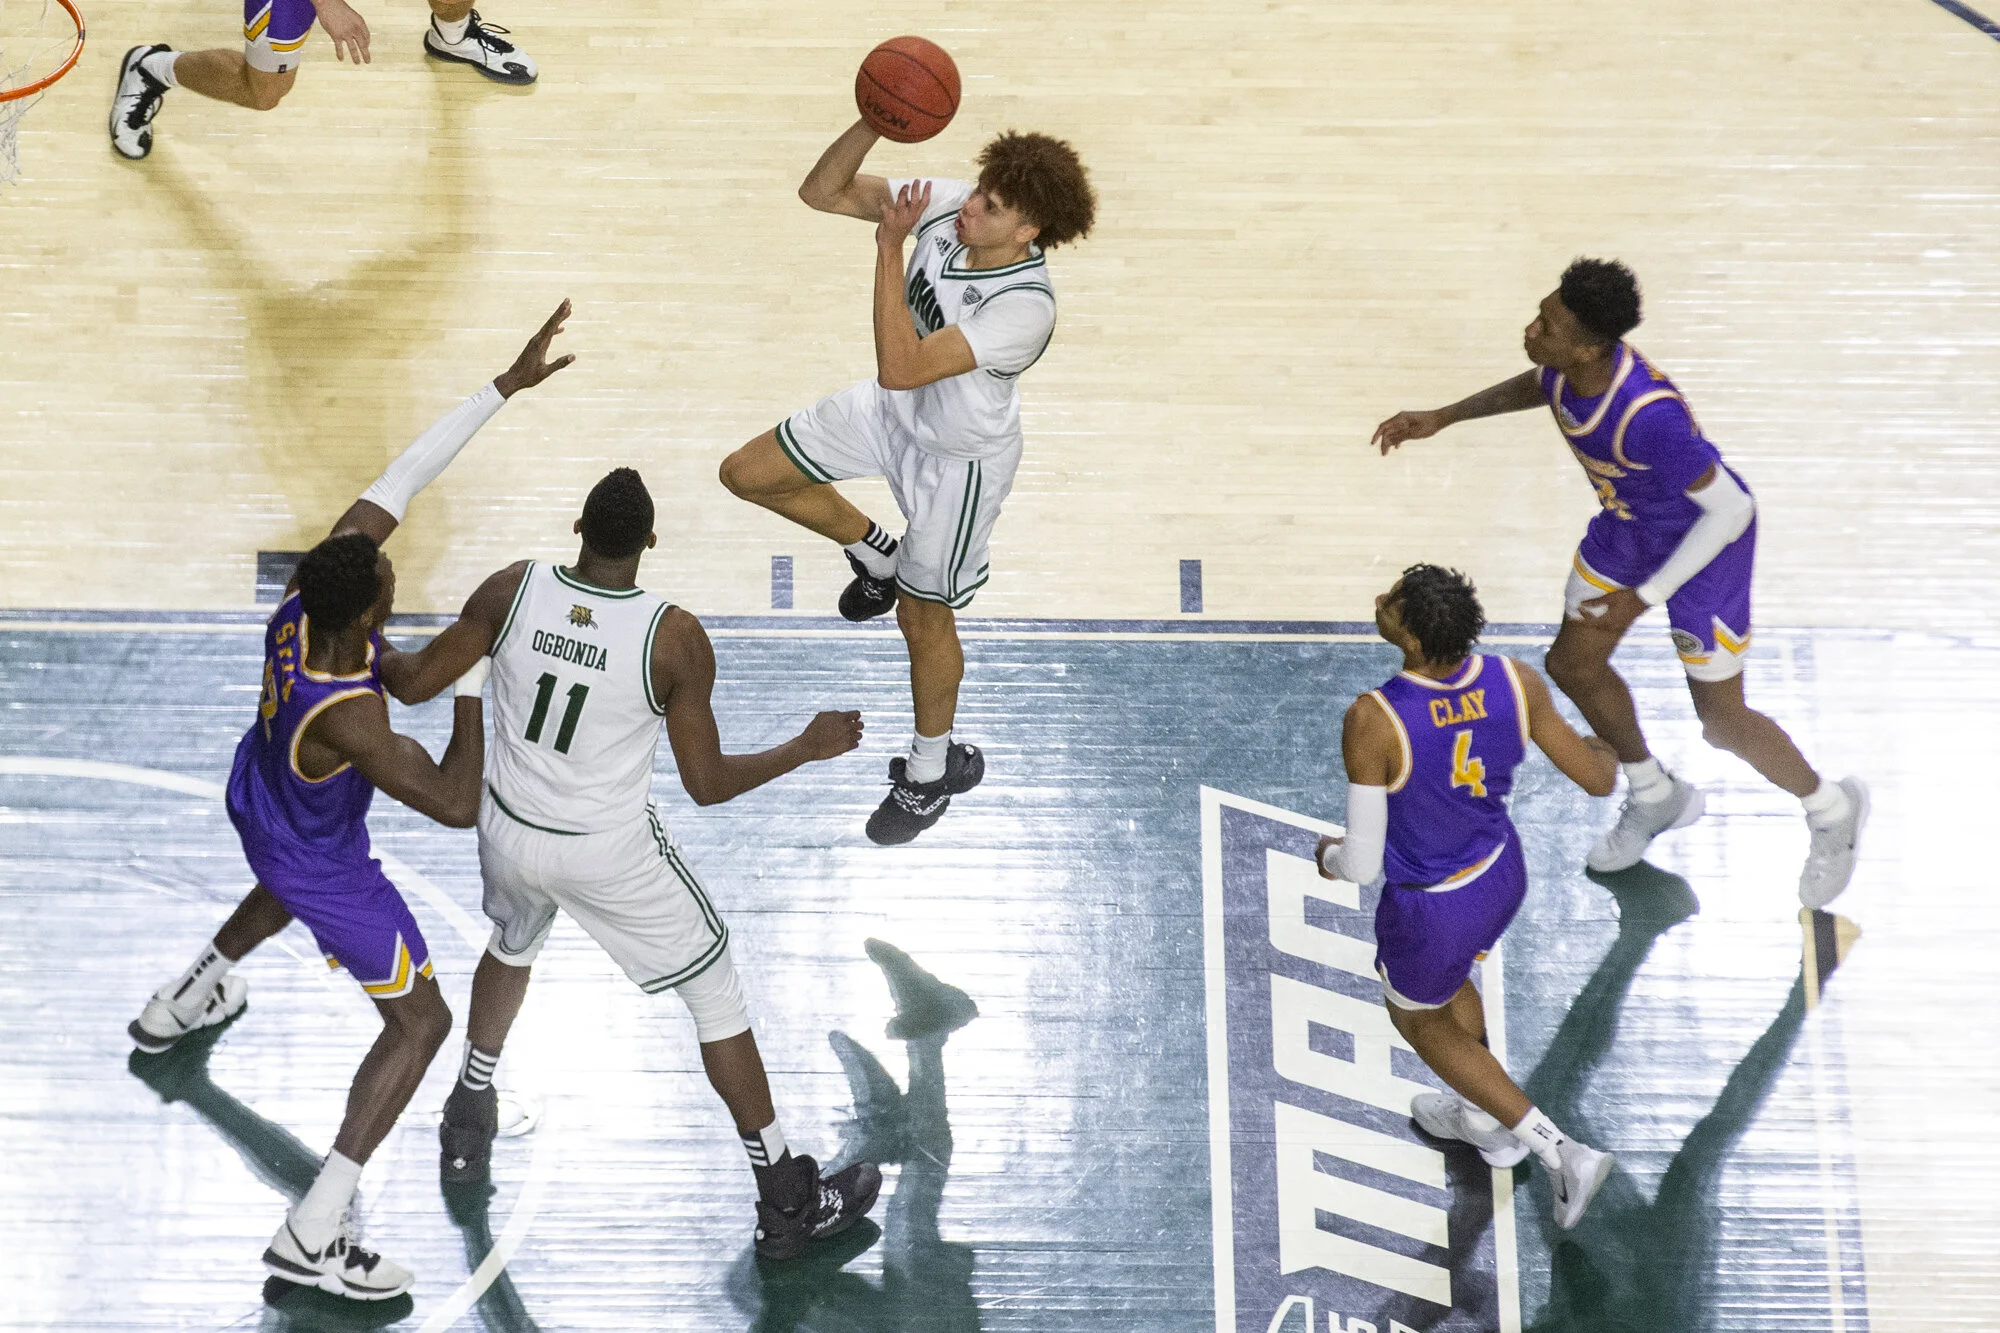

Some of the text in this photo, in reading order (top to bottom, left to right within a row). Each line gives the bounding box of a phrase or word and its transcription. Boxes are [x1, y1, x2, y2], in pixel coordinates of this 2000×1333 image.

[532, 629, 608, 672] OGBONDA
[524, 671, 590, 755] 11
[1429, 689, 1488, 728] CLAY
[1452, 729, 1488, 798] 4
